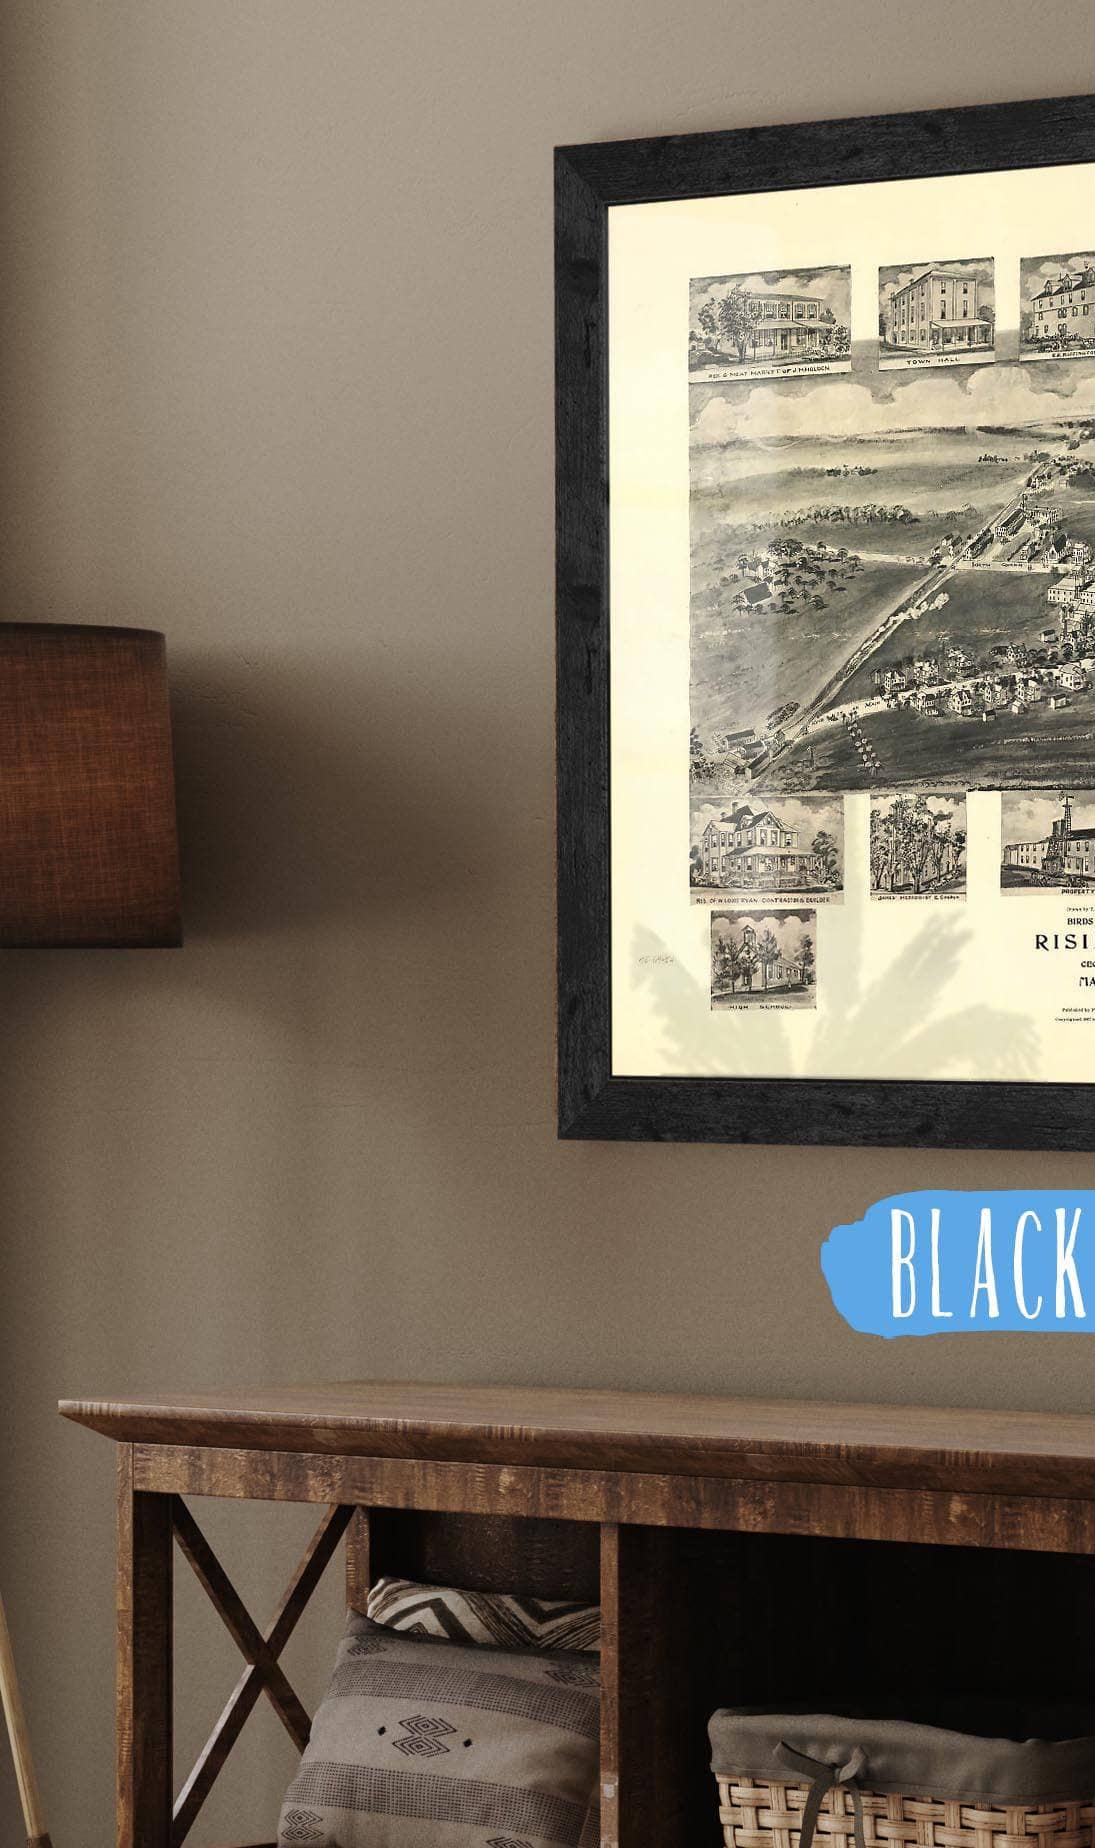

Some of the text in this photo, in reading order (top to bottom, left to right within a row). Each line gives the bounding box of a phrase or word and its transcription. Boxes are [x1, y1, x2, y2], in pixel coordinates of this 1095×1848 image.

[906, 356, 960, 366] TOWN HALL
[1067, 917, 1094, 925] BIRDS
